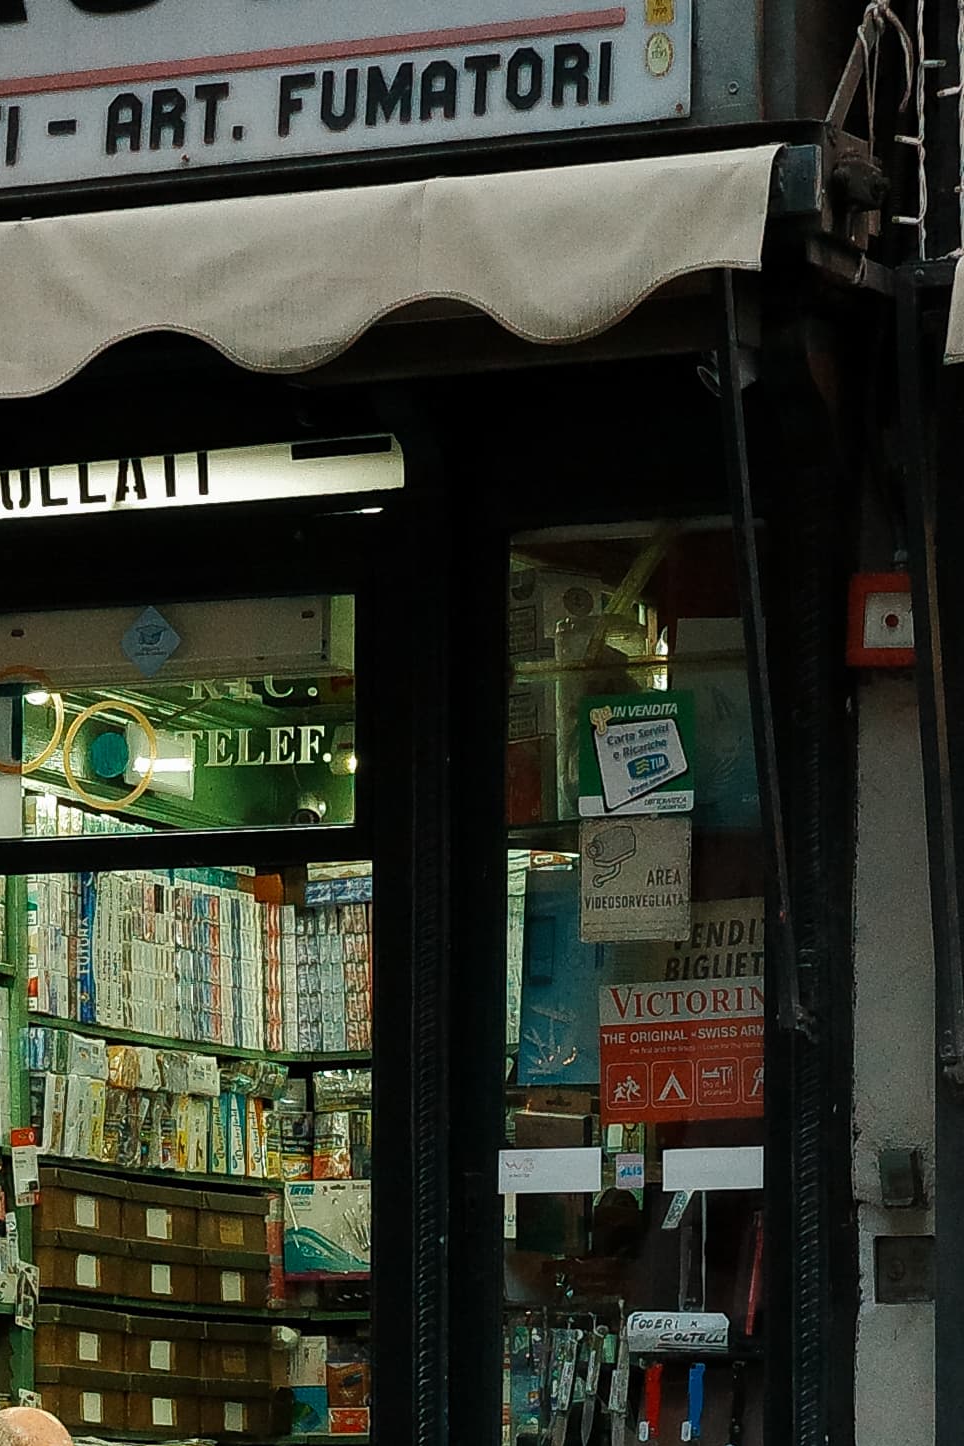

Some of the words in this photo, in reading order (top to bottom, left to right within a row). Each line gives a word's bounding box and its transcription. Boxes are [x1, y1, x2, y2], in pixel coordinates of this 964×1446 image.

[106, 79, 244, 155] ART.
[276, 41, 612, 138] FUMATORI
[613, 705, 627, 717] IN
[628, 702, 678, 717] VENDITA
[606, 732, 636, 746] Carta
[637, 723, 669, 739] Servizi
[175, 725, 332, 768] TELEF.
[623, 738, 667, 757] Ricariche
[646, 868, 682, 886] AREA
[584, 894, 685, 910] VIDEOSORVEGLIATA
[675, 918, 764, 950] ENDI
[602, 1033, 626, 1045] THE
[629, 1029, 689, 1044] ORIGINAL
[630, 1313, 678, 1331] FODERI
